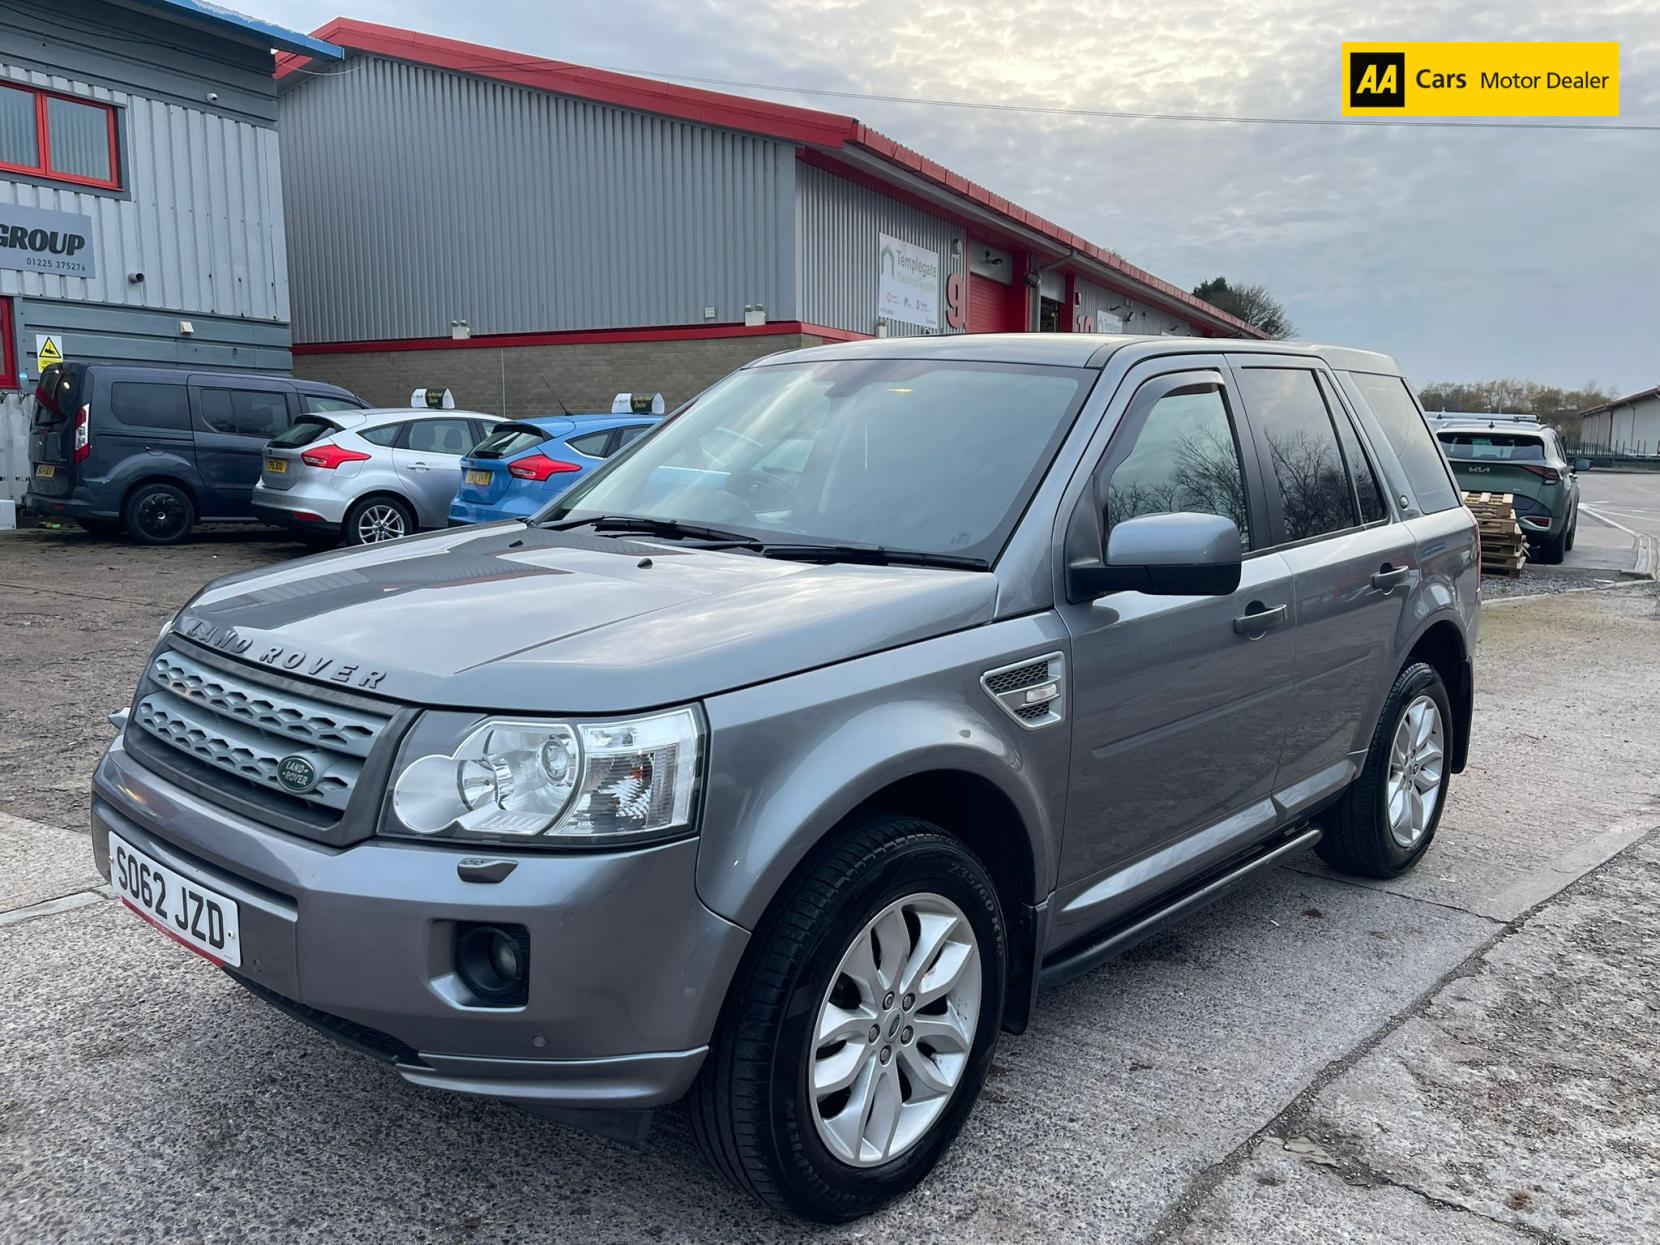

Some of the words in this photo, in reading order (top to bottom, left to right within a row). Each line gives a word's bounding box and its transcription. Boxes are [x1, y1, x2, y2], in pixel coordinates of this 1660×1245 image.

[26, 256, 53, 268] 01225
[56, 260, 86, 272] 375276
[896, 249, 937, 279] Templegate
[946, 273, 966, 329] 9
[186, 621, 254, 654] LAND
[259, 645, 387, 690] ROVER
[283, 771, 309, 786] ROVER
[285, 760, 305, 774] LAND
[174, 886, 225, 950] JZD
